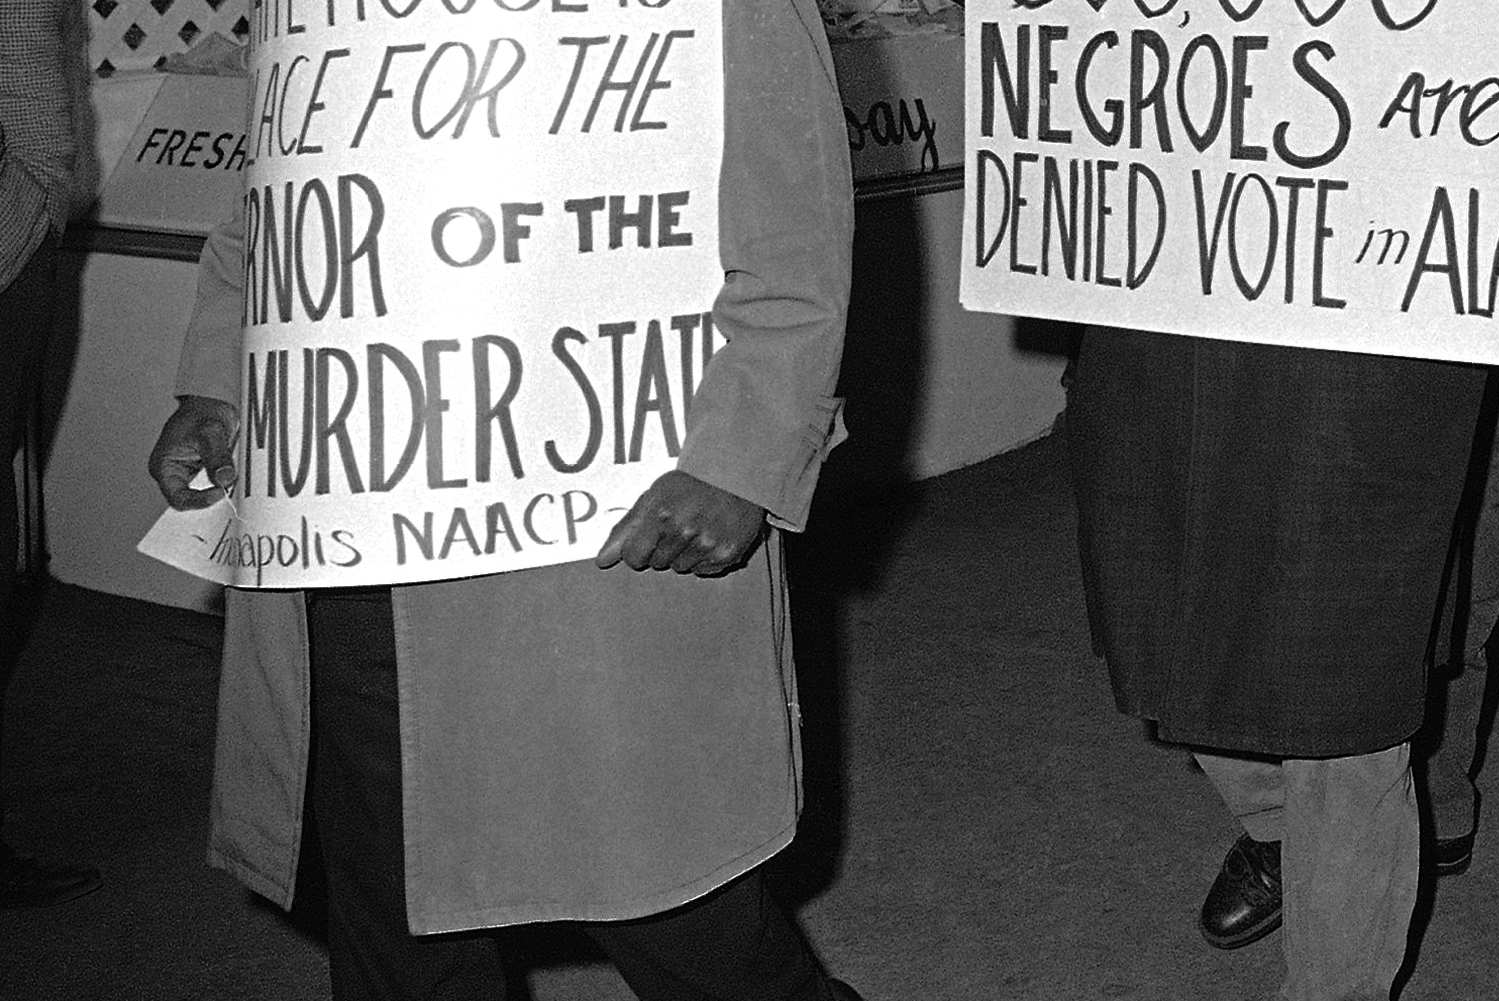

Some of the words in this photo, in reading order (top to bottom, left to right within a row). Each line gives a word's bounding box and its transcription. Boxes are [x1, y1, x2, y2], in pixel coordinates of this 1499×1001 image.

[350, 38, 528, 149] FOR
[548, 30, 696, 135] THE
[980, 21, 1352, 169] NEGROES
[242, 172, 388, 329] RNOR
[430, 202, 545, 268] OF
[564, 190, 693, 254] THE
[976, 149, 1168, 290] DENIED
[1191, 168, 1350, 310] VOTE
[1354, 220, 1411, 266] in
[244, 335, 525, 499] MURDER
